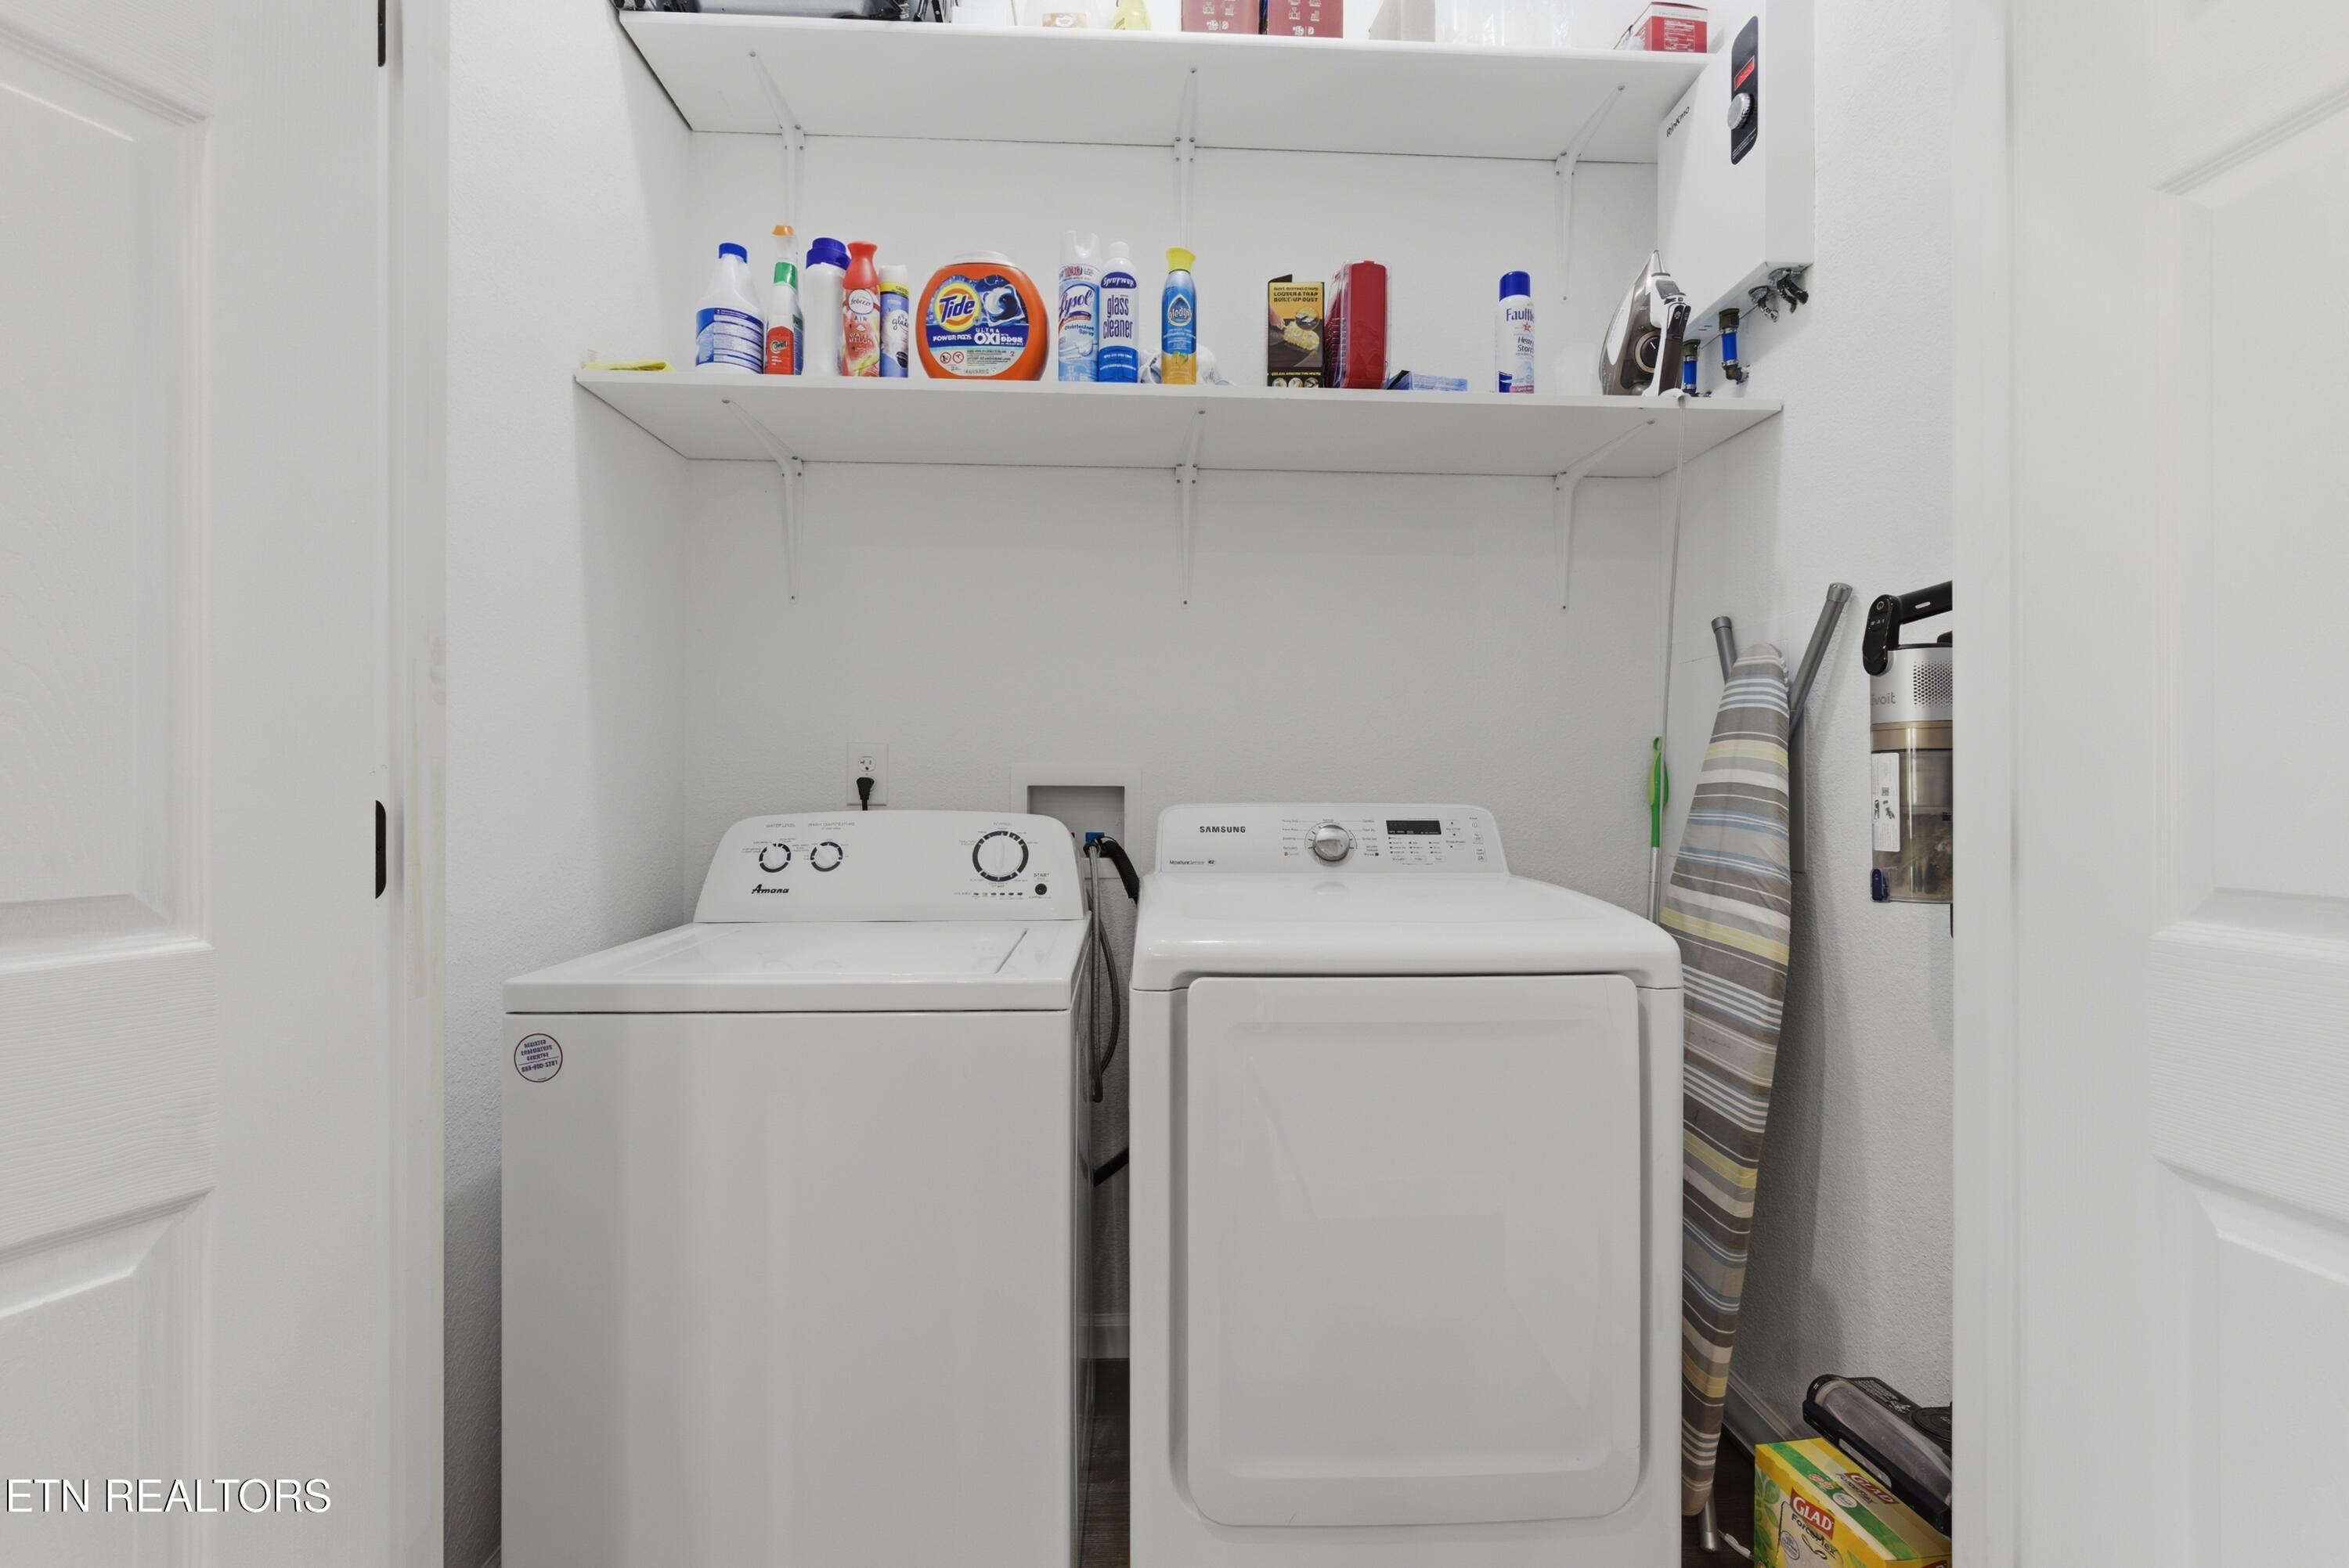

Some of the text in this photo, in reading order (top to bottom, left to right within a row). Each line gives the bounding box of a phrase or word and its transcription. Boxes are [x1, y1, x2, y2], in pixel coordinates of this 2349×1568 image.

[940, 294, 976, 323] Tide
[1106, 294, 1129, 319] glass
[973, 332, 1001, 344] OXI
[1102, 319, 1133, 339] cleaner
[751, 883, 790, 895] Amana
[1792, 1496, 1833, 1531] GLAD
